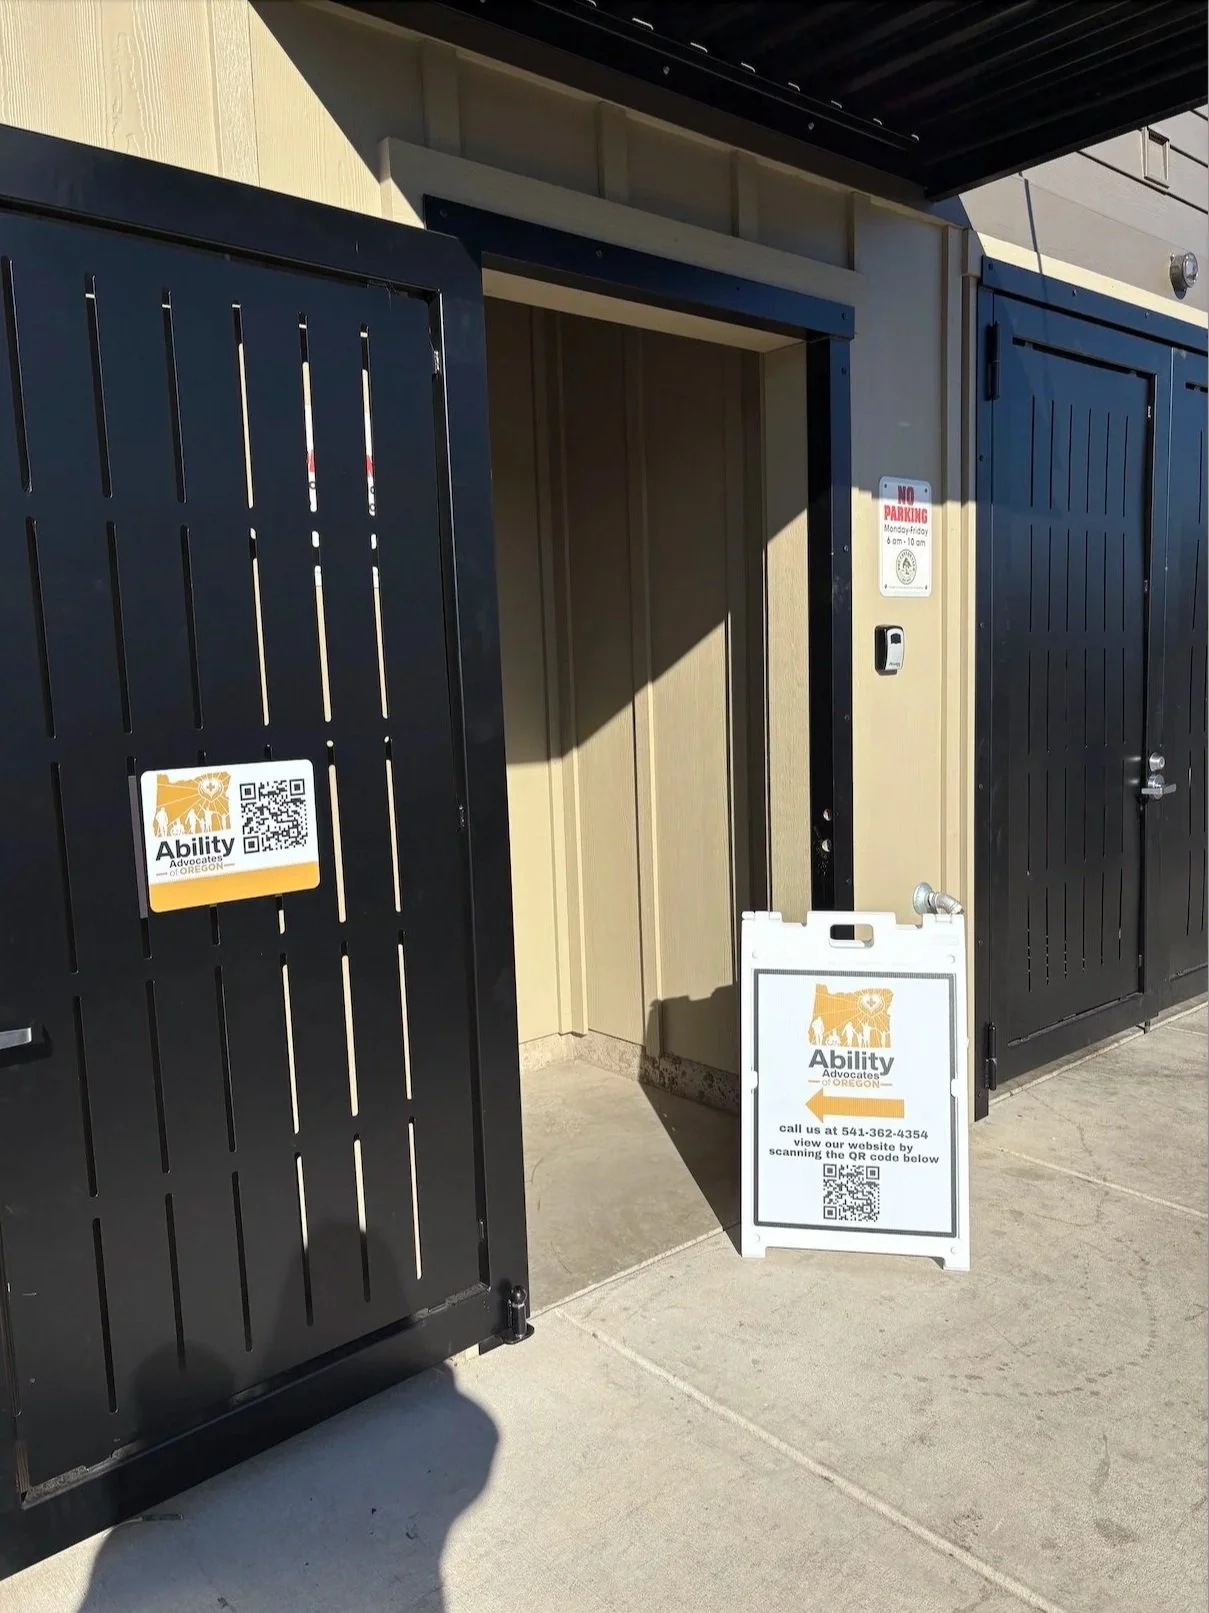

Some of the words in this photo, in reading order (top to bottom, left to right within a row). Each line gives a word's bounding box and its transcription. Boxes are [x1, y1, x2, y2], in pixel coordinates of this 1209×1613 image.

[897, 485, 915, 505] NO
[883, 504, 928, 524] PARKING
[884, 524, 928, 537] Monday-Friday
[886, 537, 891, 545] 6
[907, 538, 914, 547] 10
[155, 835, 235, 861] Ability
[169, 854, 223, 869] Advocates
[169, 869, 178, 877] of
[179, 862, 224, 875] OREGON
[808, 1049, 895, 1076] Ability
[822, 1069, 880, 1080] Advocates
[822, 1078, 832, 1087] of
[833, 1078, 880, 1088] OREGON
[779, 1123, 802, 1134] call
[806, 1126, 821, 1135] us
[825, 1126, 838, 1136] at
[842, 1127, 929, 1140] 541-362-4354
[794, 1138, 821, 1148] view
[825, 1140, 844, 1149] our
[848, 1140, 896, 1152] website
[899, 1142, 914, 1154] by
[769, 1147, 822, 1160] scanning
[826, 1149, 844, 1160] the
[849, 1150, 866, 1161] QR
[870, 1152, 899, 1162] code
[903, 1153, 939, 1164] below
